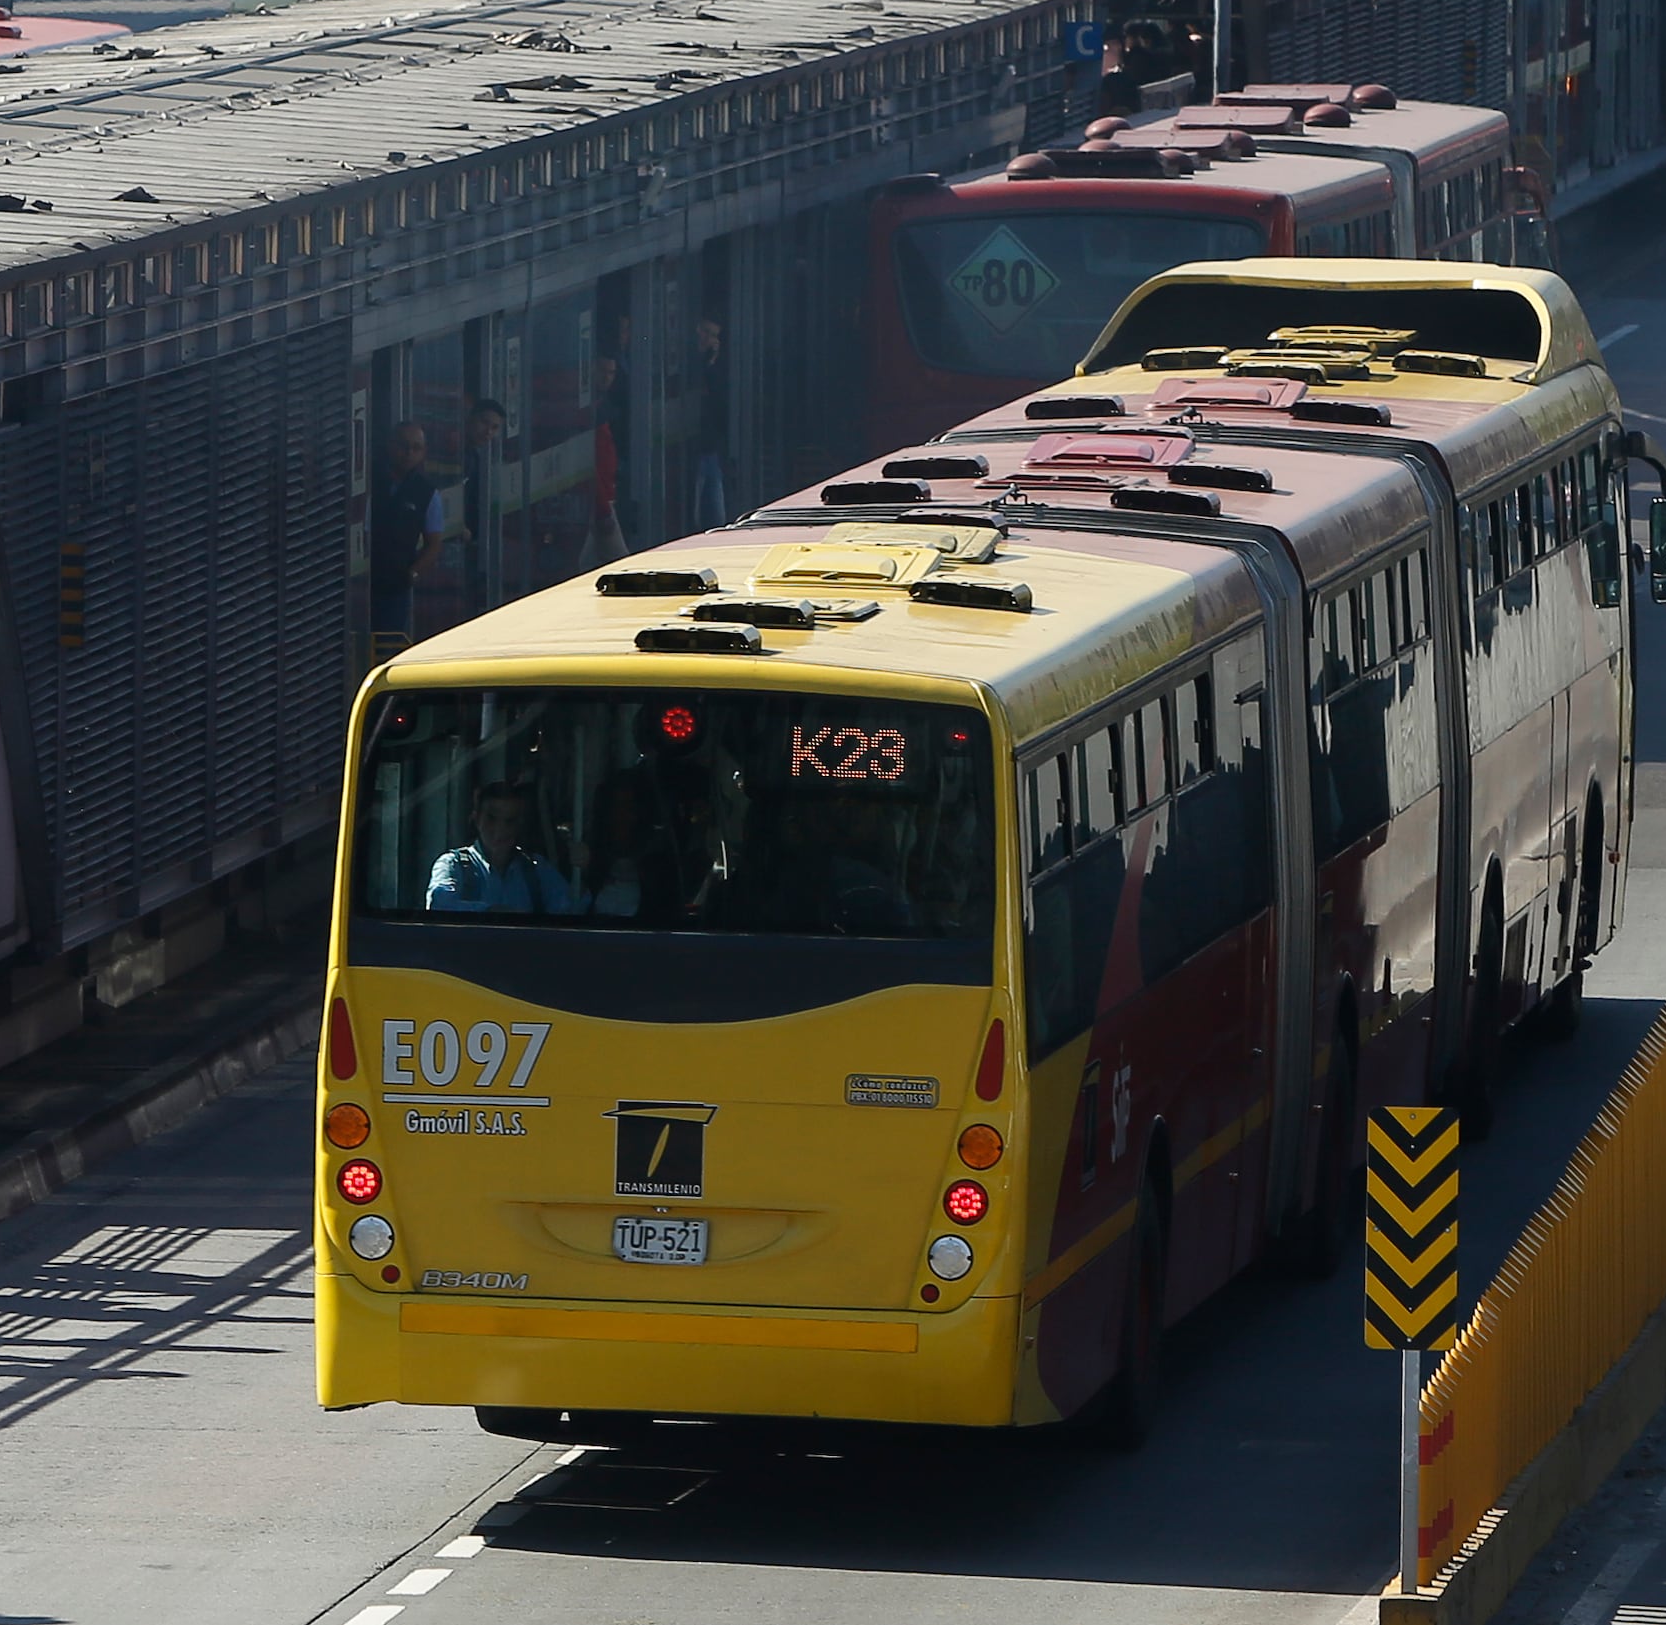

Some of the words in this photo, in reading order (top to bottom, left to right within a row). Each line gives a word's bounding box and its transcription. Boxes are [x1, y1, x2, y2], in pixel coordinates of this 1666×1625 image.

[1076, 25, 1095, 56] C
[961, 275, 982, 291] TP
[982, 258, 1035, 307] 80
[791, 725, 906, 779] K23
[383, 1019, 553, 1088] E097
[405, 1109, 470, 1134] Gmóvil
[475, 1111, 527, 1136] S.A.S.
[617, 1181, 701, 1195] TRANSMILENIO
[617, 1224, 701, 1253] TUP-521
[421, 1269, 530, 1291] B340M
